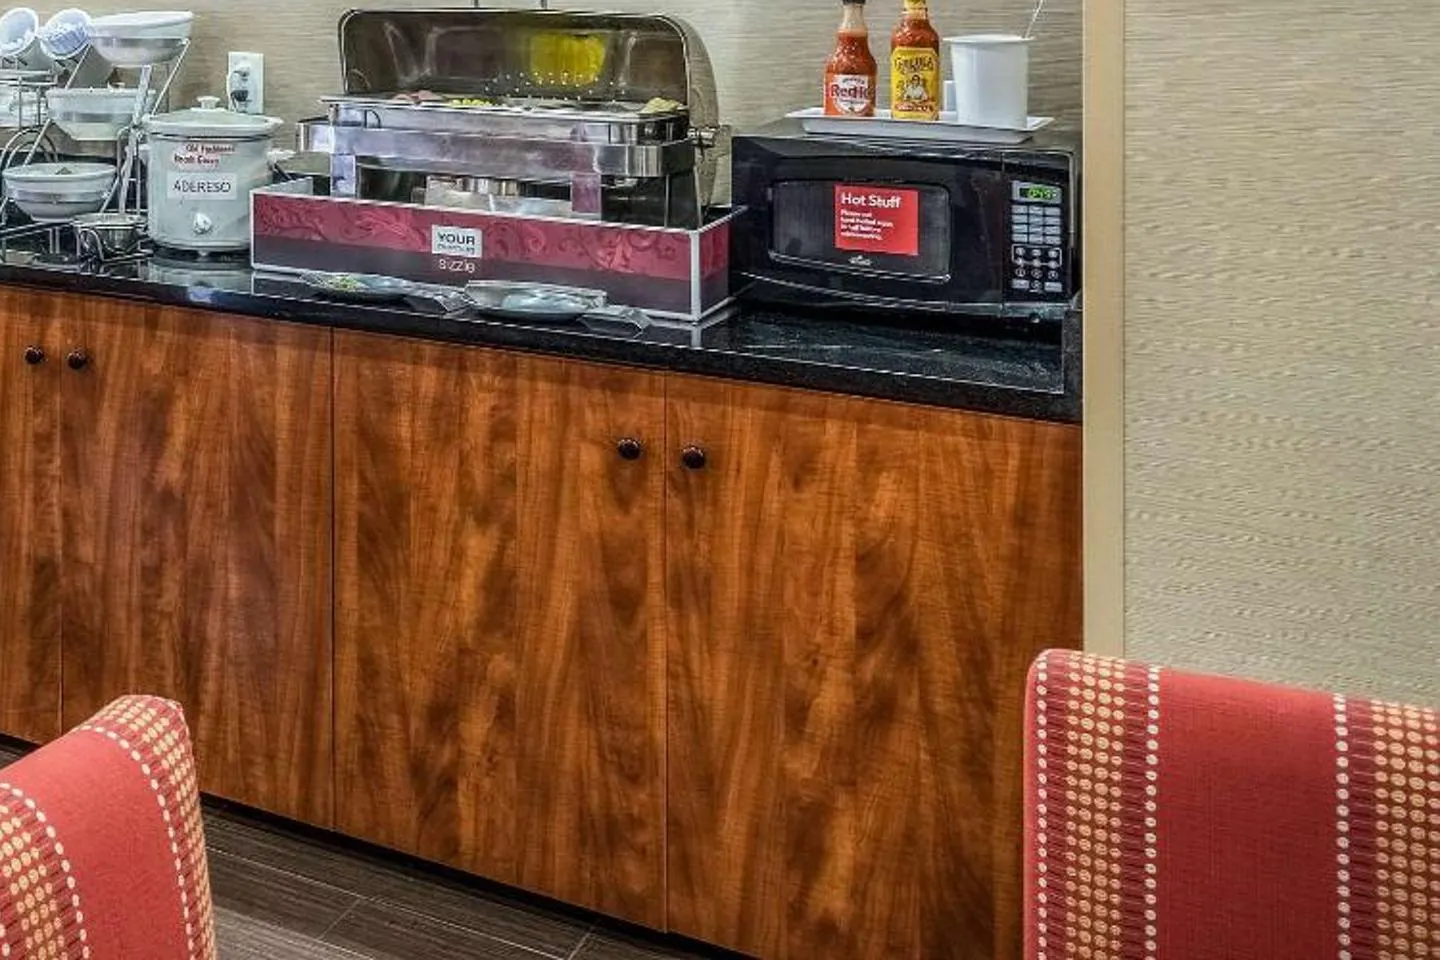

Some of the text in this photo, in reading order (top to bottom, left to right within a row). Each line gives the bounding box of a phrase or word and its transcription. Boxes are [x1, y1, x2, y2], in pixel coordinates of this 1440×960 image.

[172, 179, 231, 193] ADERESO
[840, 192, 901, 209] Hot Stuff
[437, 232, 475, 246] YOUR
